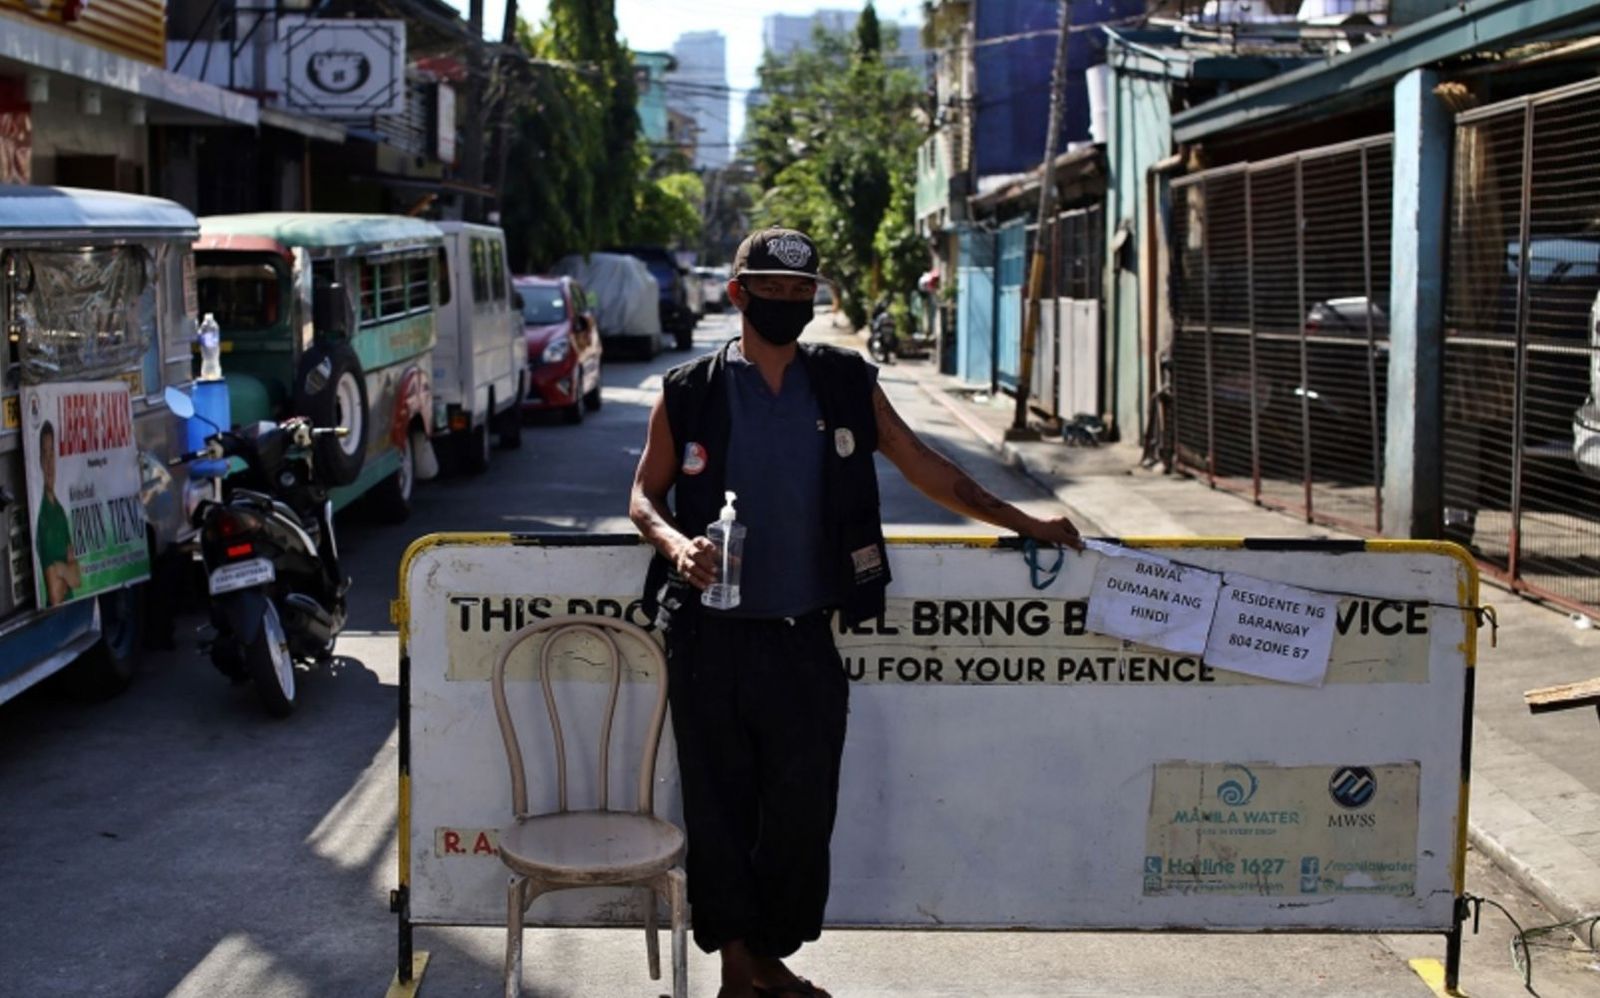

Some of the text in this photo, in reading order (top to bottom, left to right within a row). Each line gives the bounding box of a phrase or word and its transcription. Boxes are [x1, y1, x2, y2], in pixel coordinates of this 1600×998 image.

[57, 393, 98, 456] LIBRENG
[1135, 562, 1183, 583] BAWAL
[1107, 578, 1202, 609] DUMAAN ANG
[1231, 589, 1326, 619] RESIDENTE NG
[450, 596, 553, 632] THIS
[914, 600, 1050, 636] BRING
[1336, 600, 1430, 636] VICE
[1130, 605, 1170, 624] HINDI
[1238, 613, 1310, 638] BARANGAY
[1228, 633, 1310, 660] 804 ZONE 87
[878, 657, 949, 682] FOR
[954, 657, 1046, 682] YOUR
[1057, 657, 1215, 682] PATIENCE
[1173, 810, 1300, 824] MANILA WATER
[1328, 815, 1376, 829] MWSS
[444, 831, 467, 854] R.
[1167, 856, 1286, 875] Hotline 1627
